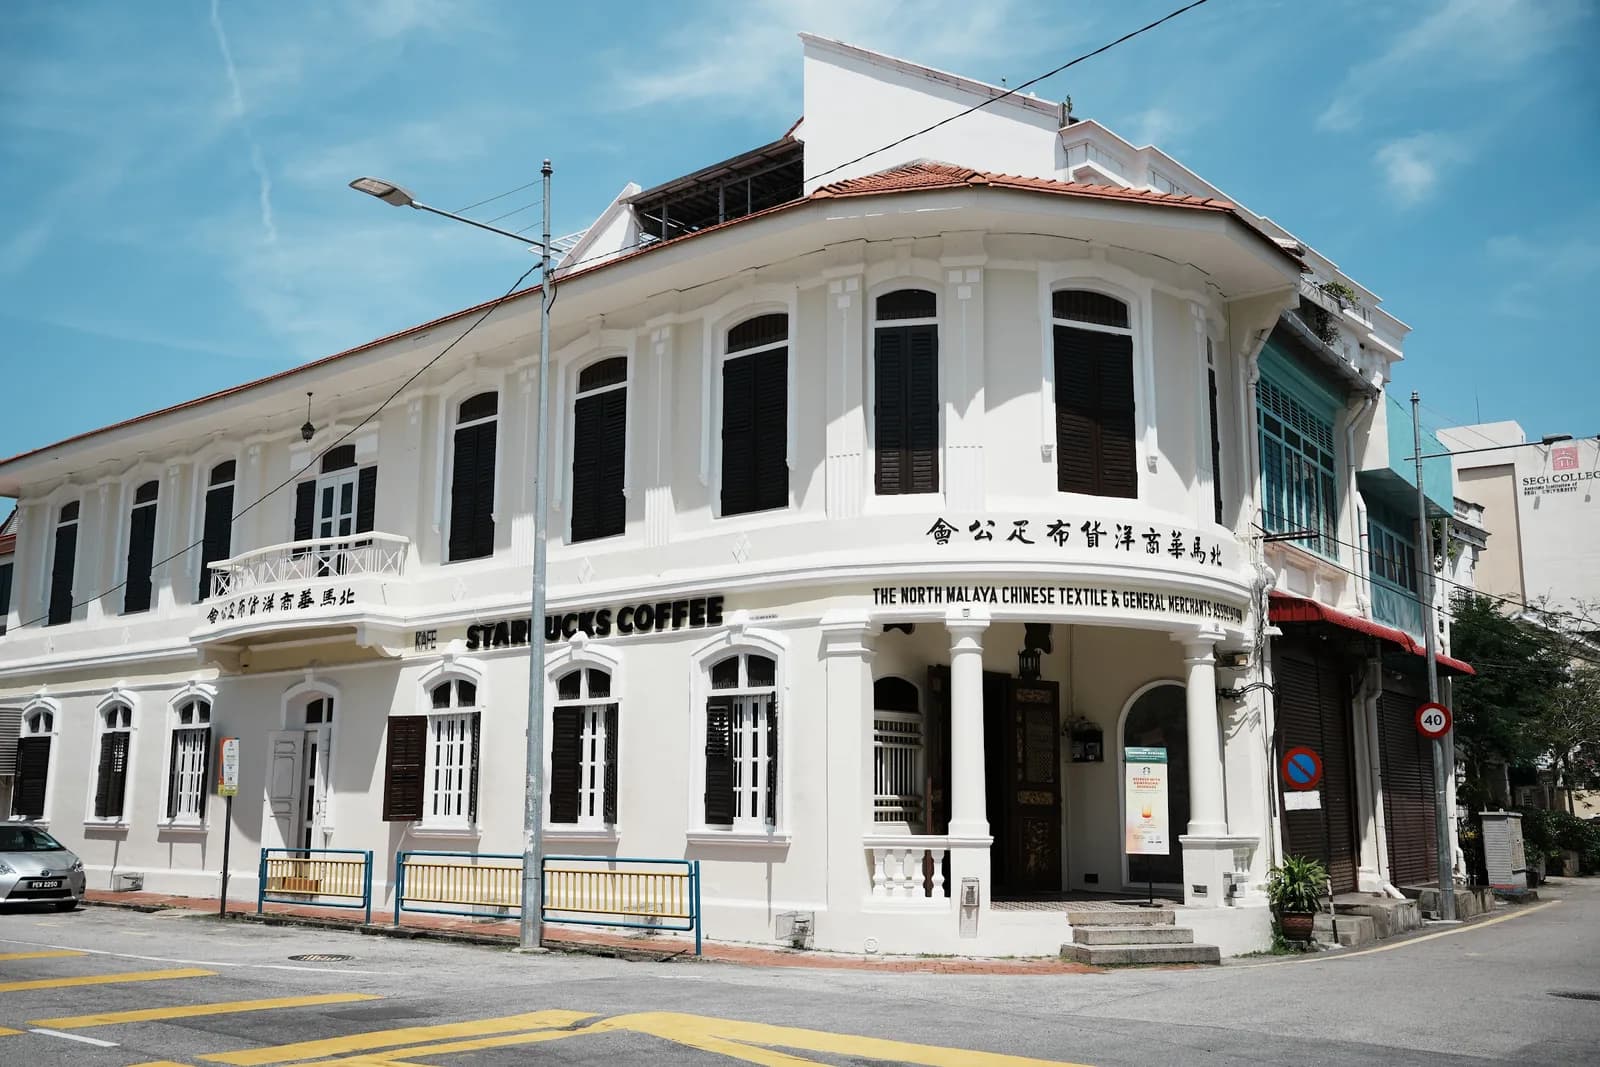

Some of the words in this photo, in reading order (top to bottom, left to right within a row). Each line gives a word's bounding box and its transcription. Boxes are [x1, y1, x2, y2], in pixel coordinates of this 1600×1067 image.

[873, 588, 897, 606] THE
[901, 586, 942, 604] NORTH
[947, 586, 998, 603] MALAYA
[1002, 586, 1055, 605] CHINESE
[1059, 587, 1109, 607] TEXTILE
[1111, 589, 1121, 607] &
[1123, 590, 1166, 612] GENERAL
[1168, 594, 1212, 617] MERCHANTS
[466, 609, 612, 650] STARUCKS
[616, 596, 724, 635] COFFEE
[415, 630, 437, 651] KAFE
[1424, 714, 1443, 726] 40
